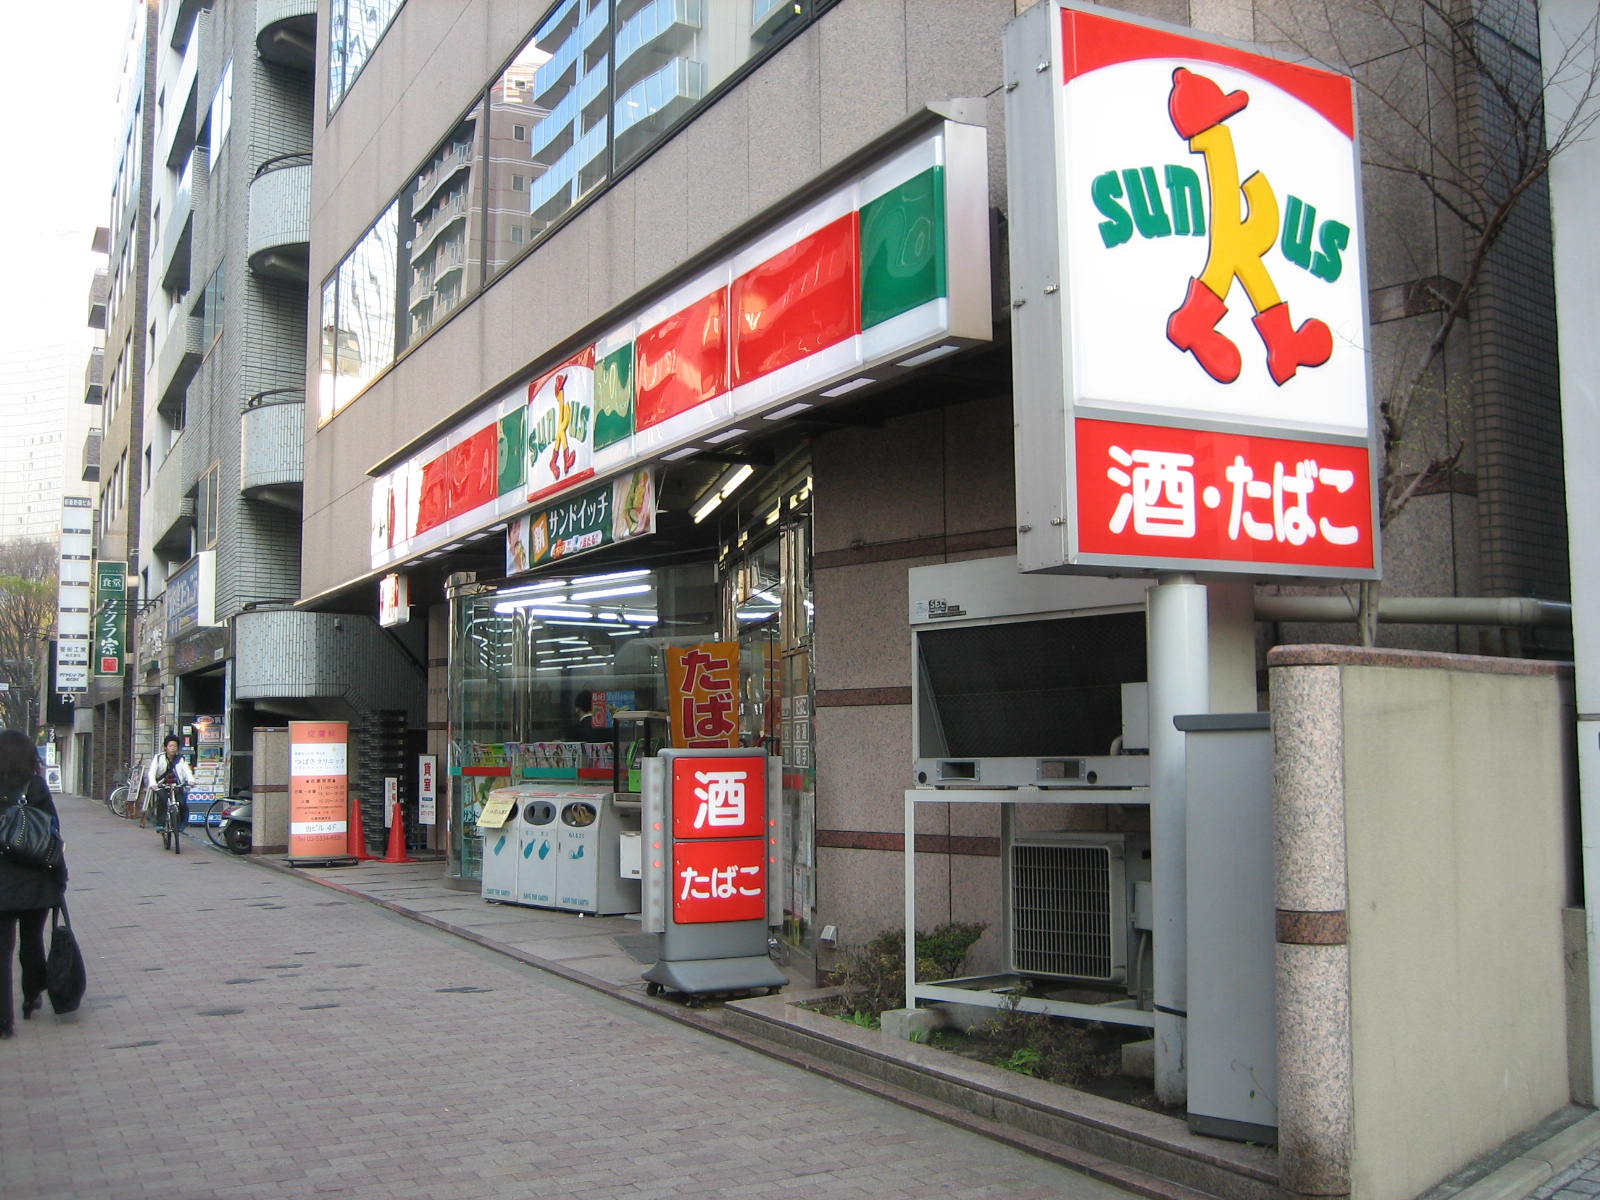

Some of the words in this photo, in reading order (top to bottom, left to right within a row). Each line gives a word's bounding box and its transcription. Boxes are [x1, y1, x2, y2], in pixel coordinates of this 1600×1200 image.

[532, 521, 546, 554] 新
[549, 491, 609, 539] サンドイッチ
[1107, 445, 1359, 546] 酒・たばこ
[294, 757, 345, 766] つばさクリニック
[693, 770, 748, 830] 酒
[680, 864, 761, 901] たばこ
